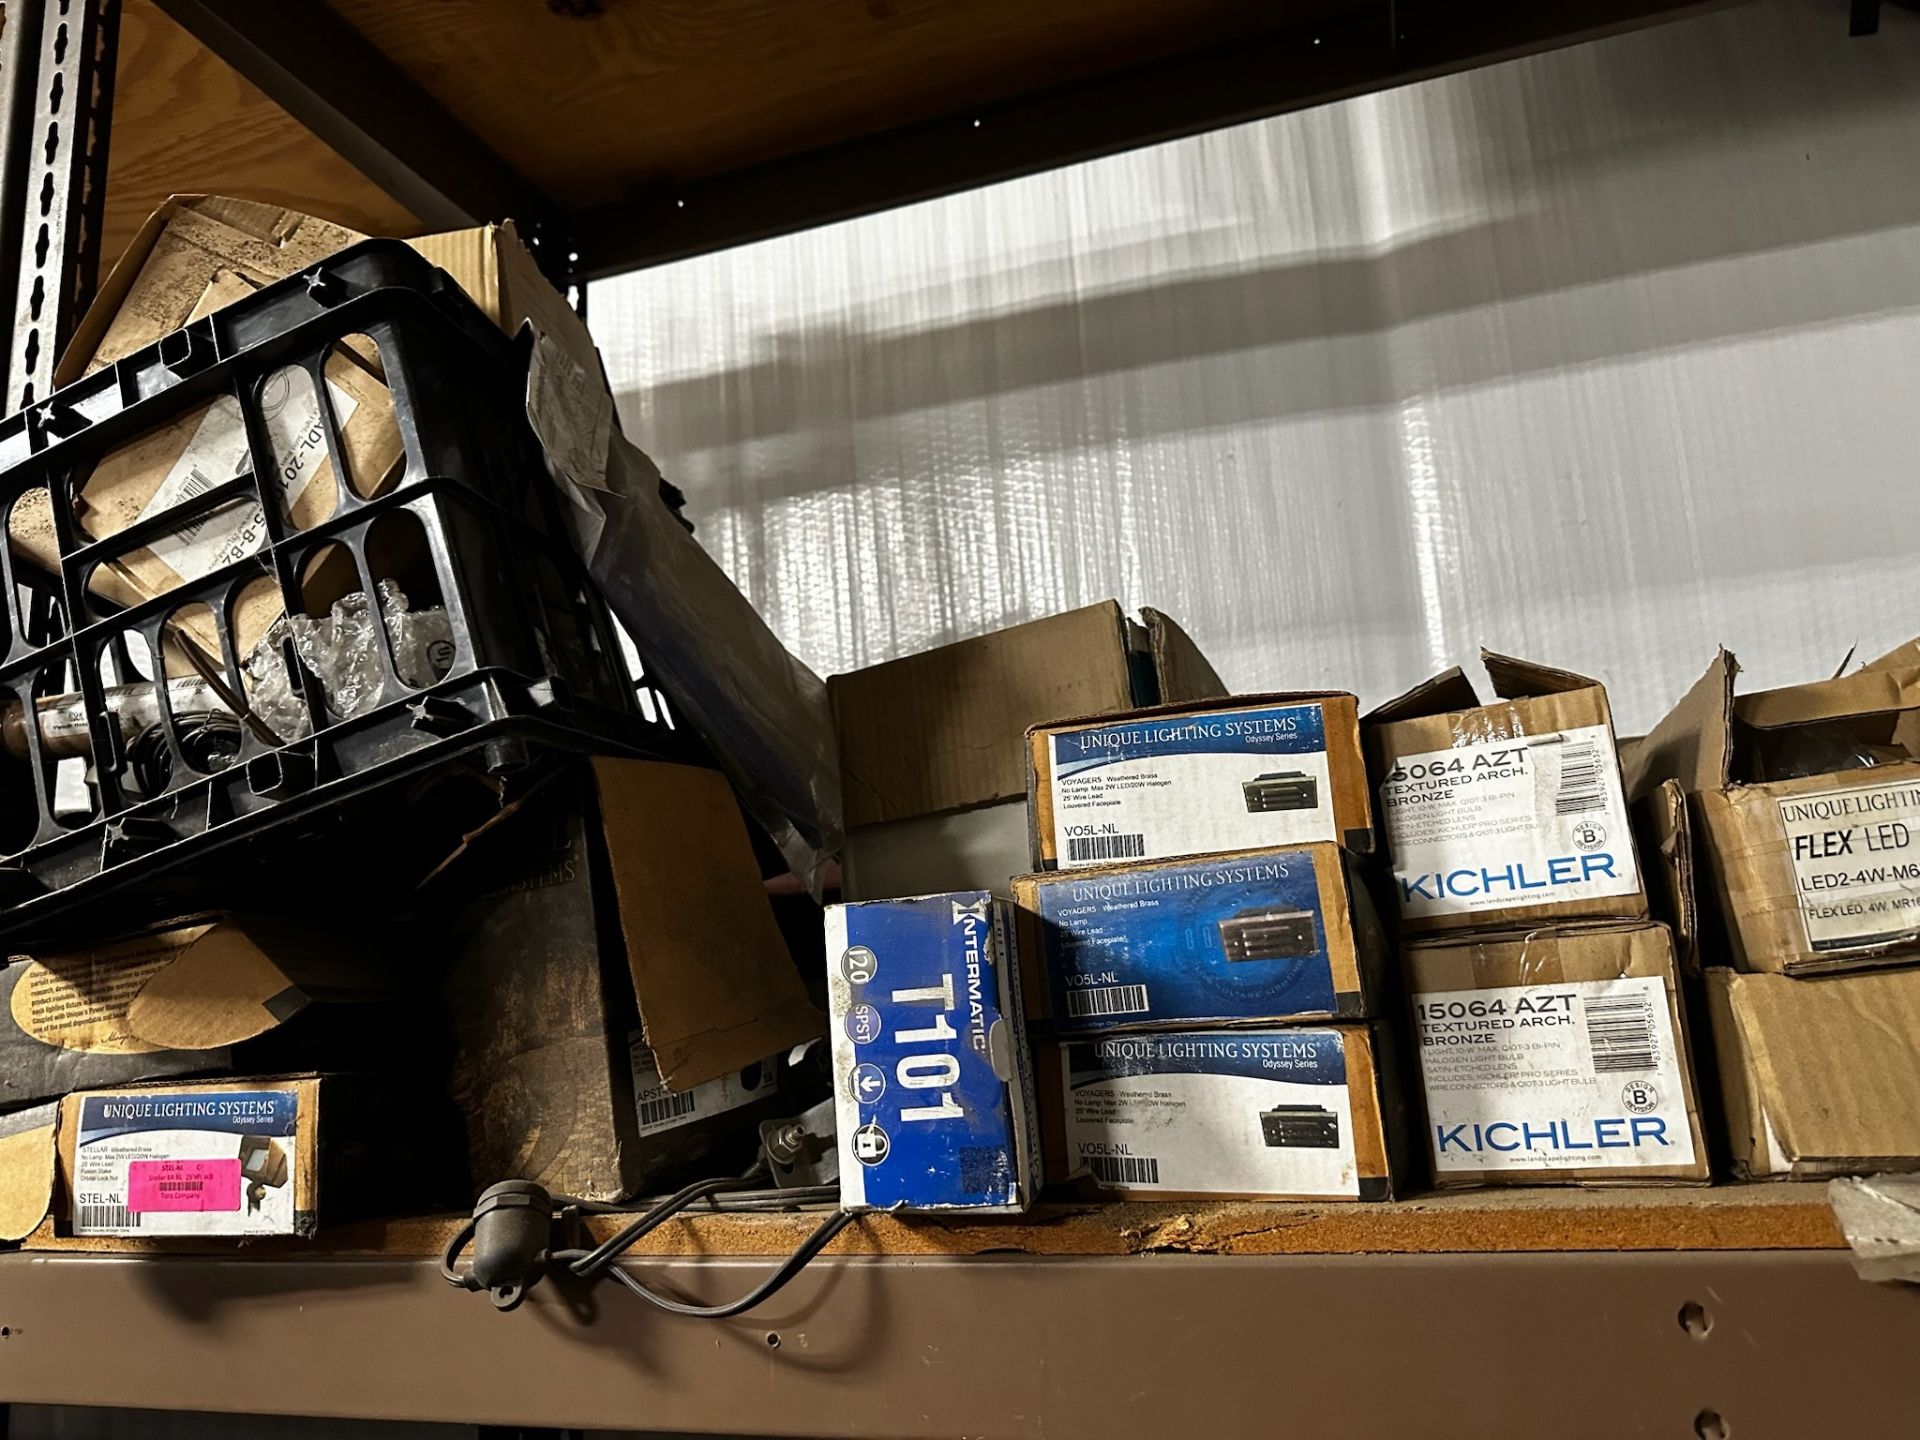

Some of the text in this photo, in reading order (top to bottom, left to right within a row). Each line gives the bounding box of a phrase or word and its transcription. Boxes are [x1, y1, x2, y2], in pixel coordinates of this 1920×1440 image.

[1080, 717, 1297, 749] UNIQUE LIGHTING SYSTEMS
[1245, 732, 1297, 745] Odyssey Series
[1472, 747, 1528, 770] AZT
[1107, 774, 1139, 782] Weathered
[1384, 767, 1528, 796] TEXTURED ARCH.
[1386, 789, 1455, 807] BRONZE
[1782, 798, 1856, 823] UNIQUE
[1064, 823, 1120, 837] VO5L-NL
[1583, 830, 1596, 843] B
[1795, 823, 1910, 861] FLEX LED
[1135, 871, 1214, 895] LIGHTING
[1216, 862, 1290, 886] SYSTEMS
[1401, 853, 1617, 902] KICHLER
[1801, 863, 1920, 891] LED2-4W-M6
[1102, 901, 1139, 912] Weathered
[1139, 899, 1159, 907] Brass
[1809, 909, 1840, 919] FLEX
[1087, 927, 1104, 935] Lead
[1065, 971, 1119, 987] VO5L-NL
[1418, 994, 1576, 1021] 15064 AZT
[856, 1005, 871, 1043] SPST
[1422, 1015, 1575, 1034] TEXTURED ARCH.
[891, 973, 964, 1122] T101
[1422, 1033, 1496, 1047] BRONZE
[1095, 1043, 1317, 1059] UNIQUE LIGHTING SYSTEMS
[1262, 1060, 1318, 1070] Odyssey Series
[1626, 1083, 1655, 1093] DESIGN
[1633, 1090, 1647, 1104] B
[104, 1101, 275, 1119] UNIQUE LIGHTING SYSTEMS
[1626, 1100, 1655, 1112] REVISION
[232, 1115, 274, 1124] Odyssey Series
[1437, 1117, 1670, 1152] KICHLER
[1077, 1143, 1133, 1156] VO5L-NL
[79, 1193, 122, 1204] STEL-NL
